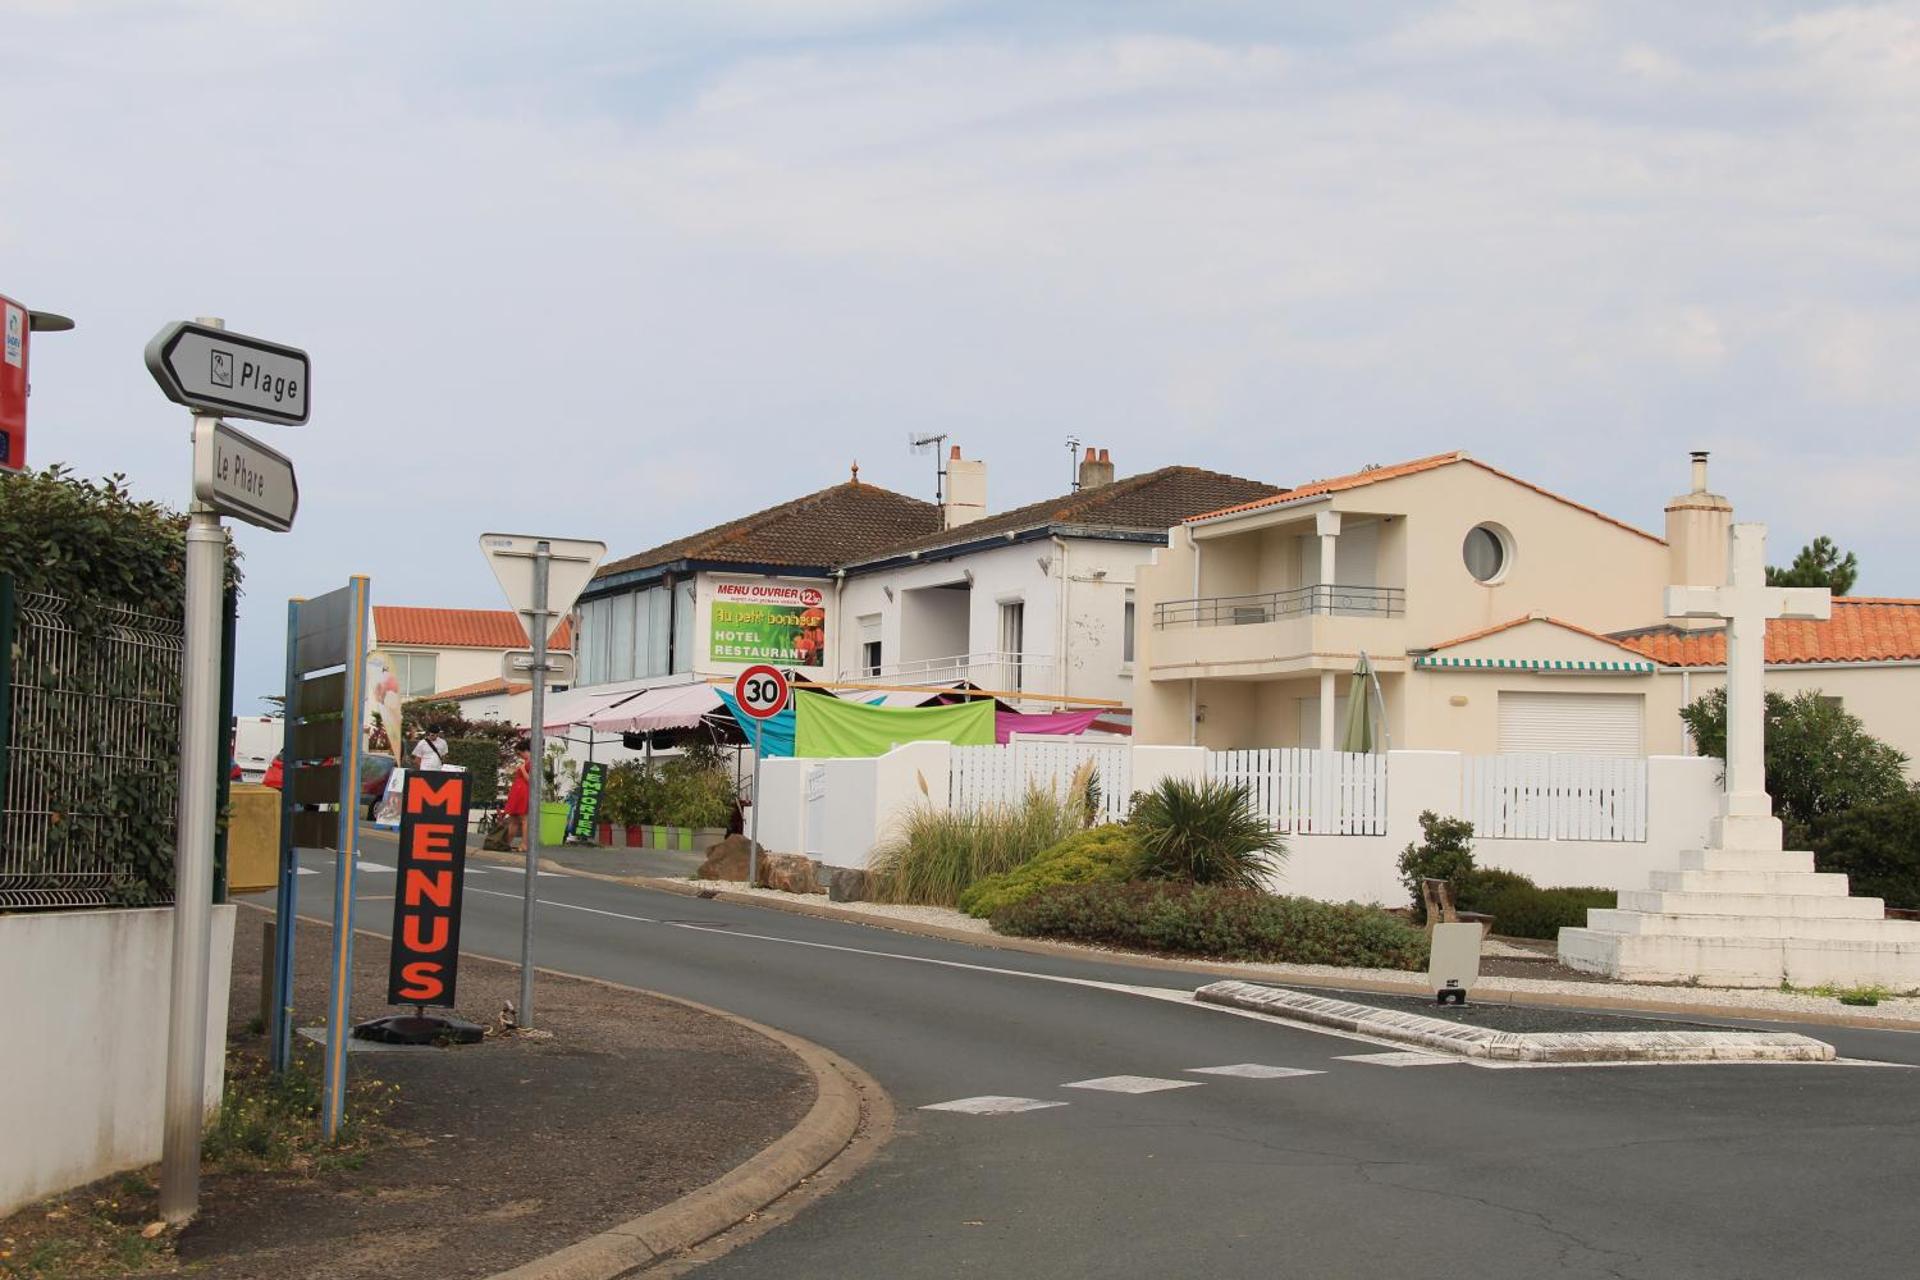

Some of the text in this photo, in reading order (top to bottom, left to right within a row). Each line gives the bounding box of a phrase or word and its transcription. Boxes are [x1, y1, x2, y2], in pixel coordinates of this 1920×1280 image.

[240, 361, 298, 402] Plage
[217, 447, 264, 497] Le Phare
[717, 586, 798, 598] MENU OUVRIER
[735, 610, 764, 626] petit
[767, 612, 820, 627] bonheur
[715, 631, 761, 643] HOTEL
[715, 645, 808, 659] RESTAURANT
[746, 680, 778, 703] 30
[576, 773, 602, 836] EMPORTER
[399, 777, 464, 999] MENUS
